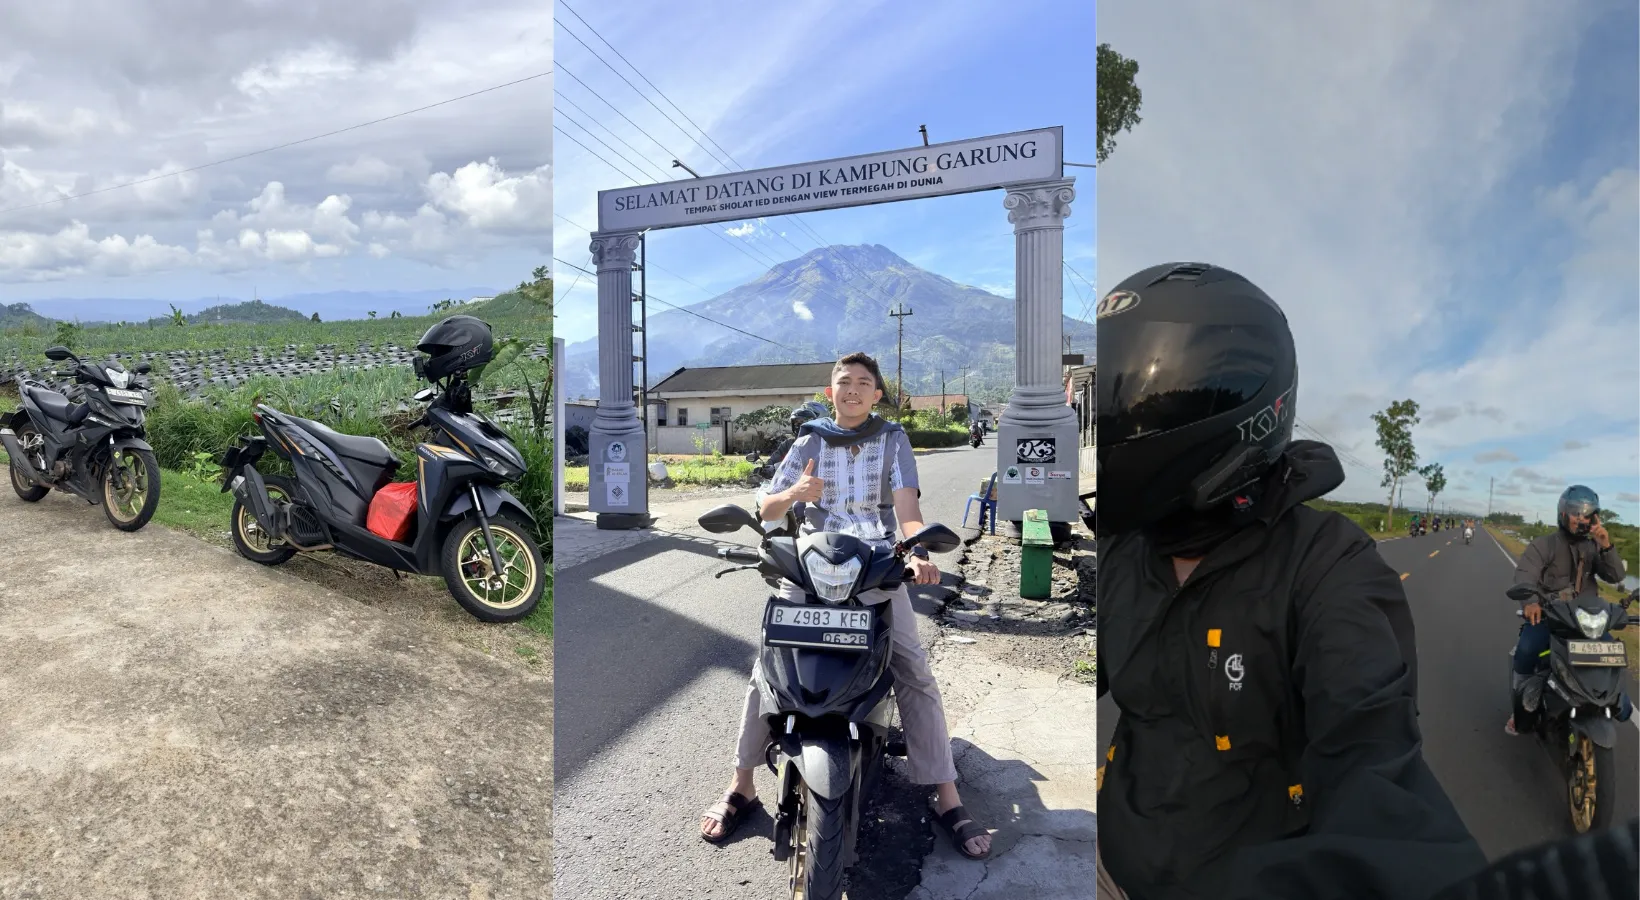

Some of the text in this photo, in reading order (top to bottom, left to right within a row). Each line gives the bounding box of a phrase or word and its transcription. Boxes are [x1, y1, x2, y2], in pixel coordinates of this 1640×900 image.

[615, 141, 1037, 212] SELAMAT DATANG DI KAMPUNG GARUNG
[684, 176, 944, 215] TEMPAT SHOLAT IED DENGAN VIEW TERMEGAH DI DUNIA
[775, 609, 784, 623] B
[793, 610, 831, 626] 4983
